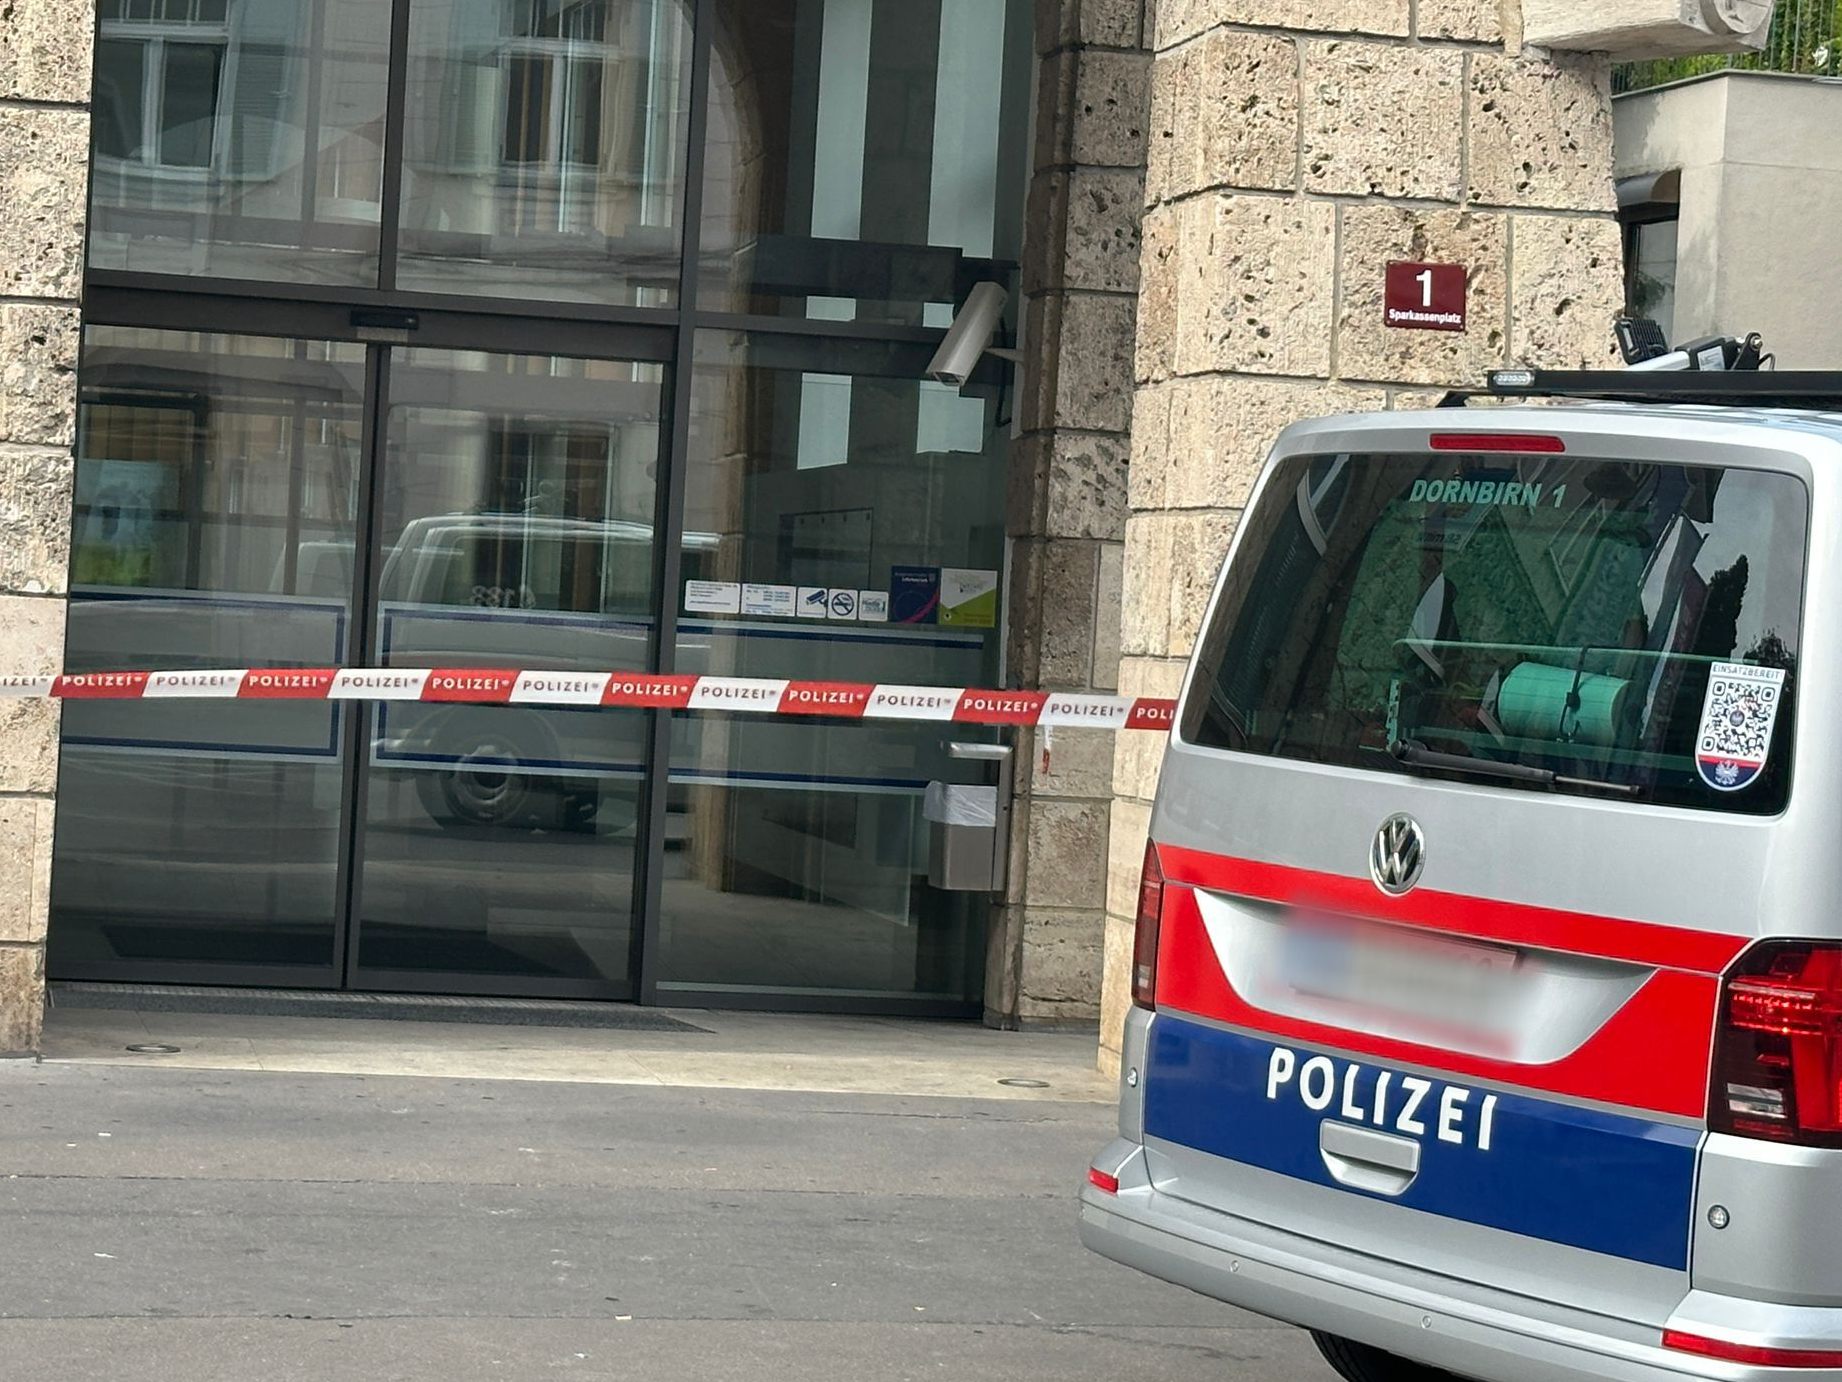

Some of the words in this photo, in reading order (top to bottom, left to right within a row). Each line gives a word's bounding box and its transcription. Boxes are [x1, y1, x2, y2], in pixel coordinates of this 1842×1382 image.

[1415, 269, 1432, 307] 1
[1388, 308, 1462, 324] Sparkassenplatz
[1409, 479, 1543, 508] DORNBIRN
[1552, 483, 1567, 508] 1
[62, 675, 132, 687] POLIZEI
[157, 676, 225, 686] POLIZEI
[249, 675, 318, 687] POLIZEI
[342, 677, 408, 688] POLIZEI
[432, 678, 500, 690] POLIZEI
[523, 680, 588, 692] POLIZEI
[612, 683, 677, 697] POLIZEI
[701, 686, 766, 699] POLIZEI
[789, 690, 853, 704] POLIZEI
[877, 694, 941, 708] POLIZEI
[963, 698, 1028, 713] POLIZEI
[1051, 703, 1114, 717] POLIZEI
[1371, 814, 1422, 894] VW
[1266, 1047, 1498, 1150] POLIZEI
